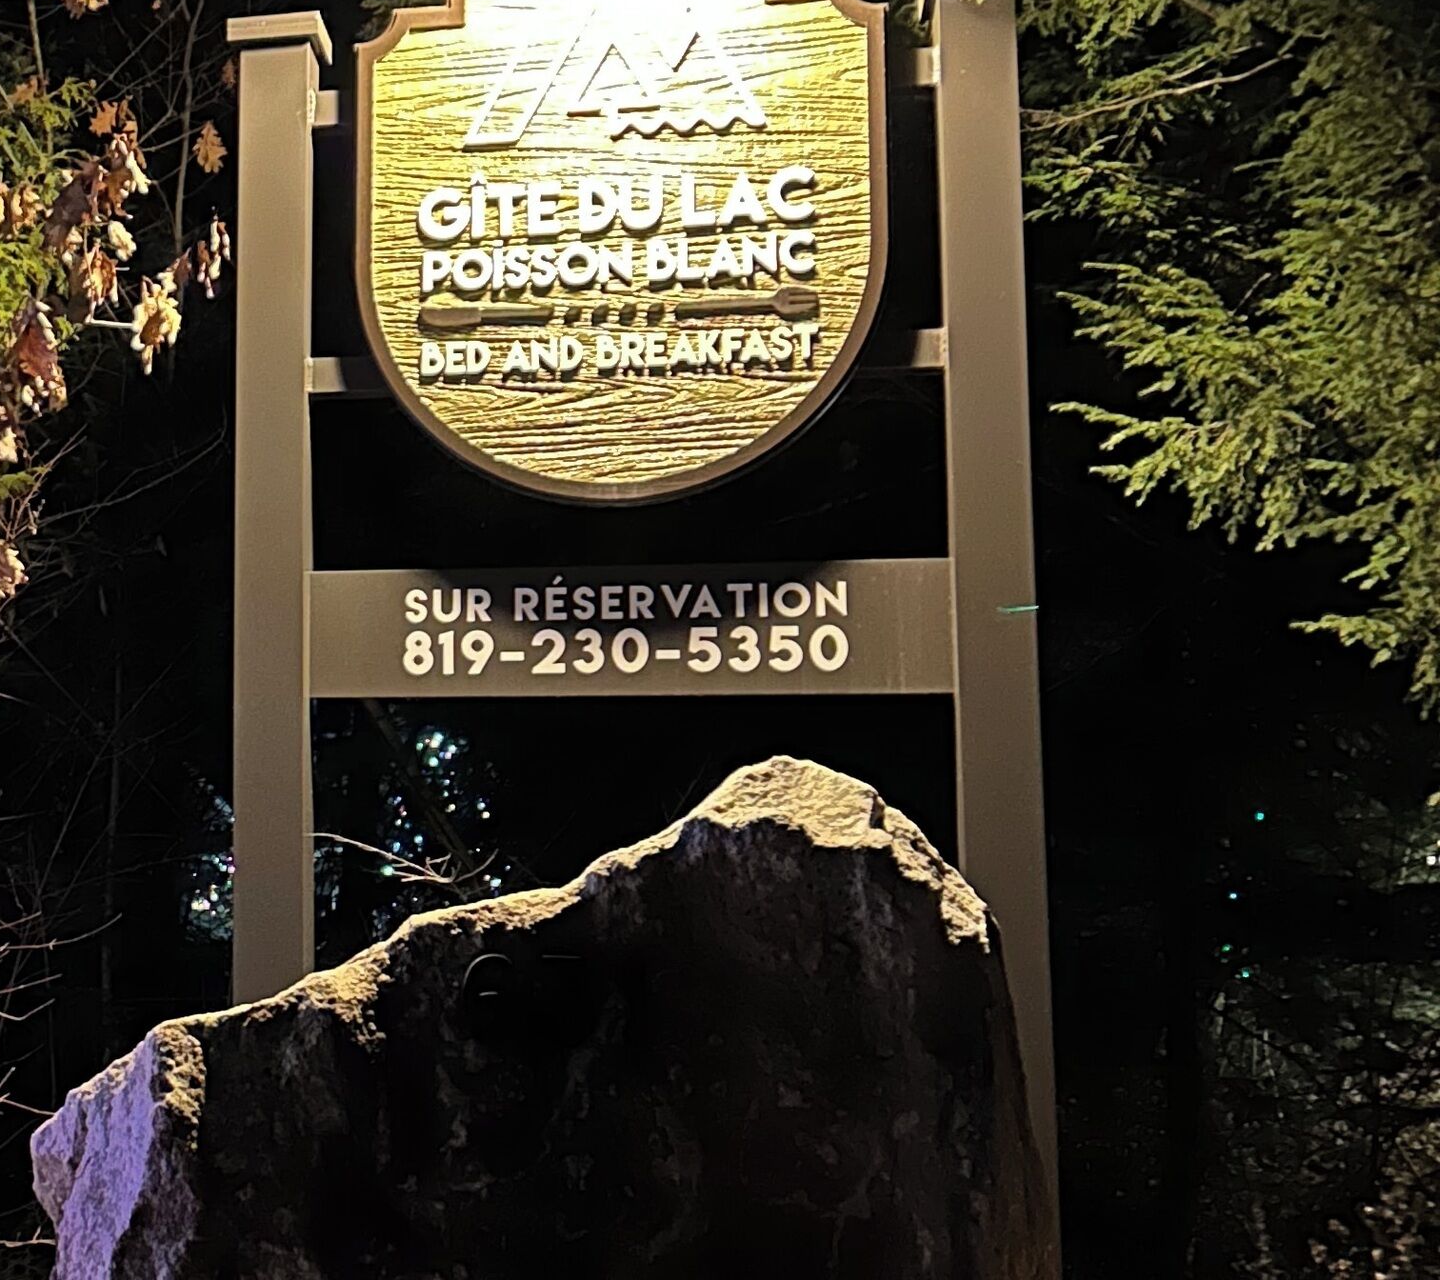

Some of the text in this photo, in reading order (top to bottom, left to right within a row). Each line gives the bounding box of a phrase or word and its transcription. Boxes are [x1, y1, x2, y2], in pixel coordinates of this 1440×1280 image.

[418, 166, 815, 241] GÎTE DU LAC
[421, 231, 815, 293] POISSON BLANC
[421, 324, 819, 377] BED AND BREAKFAST
[404, 577, 848, 623] SUR RÉSERVATION
[402, 624, 849, 676] 819-230-5350
